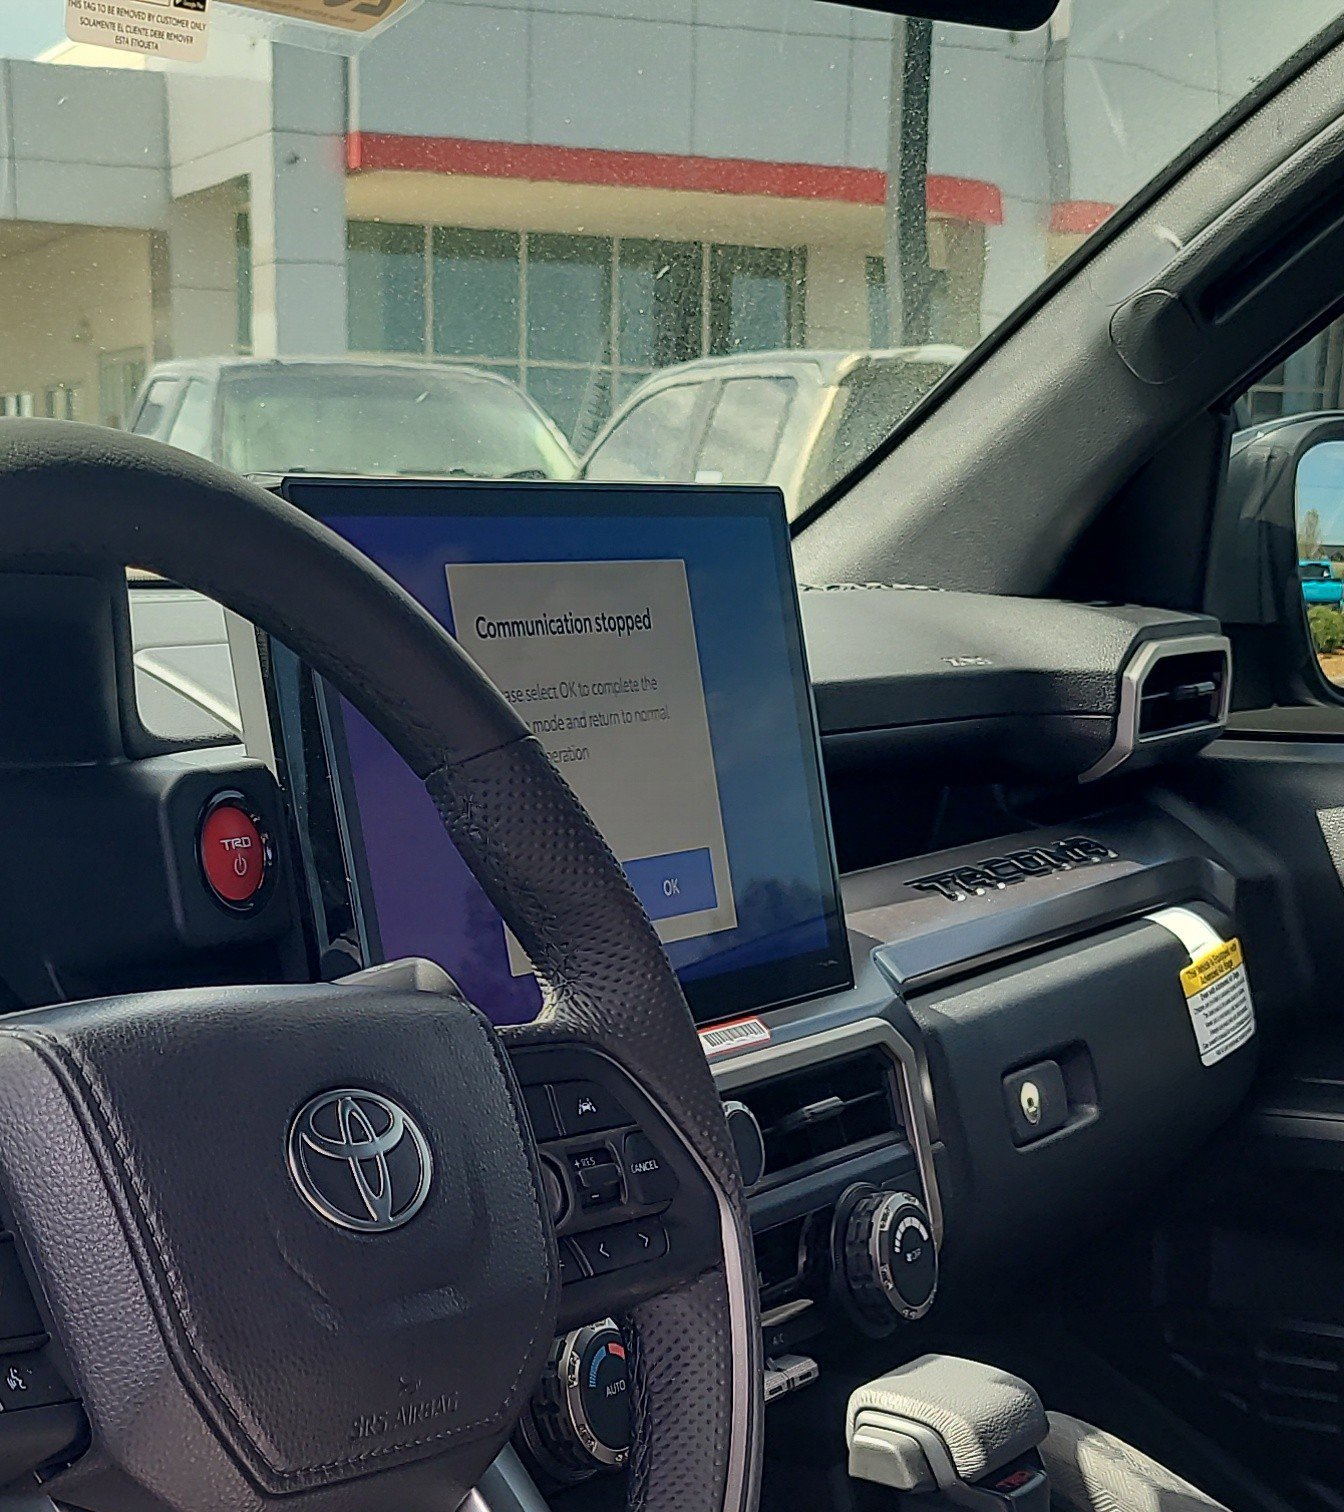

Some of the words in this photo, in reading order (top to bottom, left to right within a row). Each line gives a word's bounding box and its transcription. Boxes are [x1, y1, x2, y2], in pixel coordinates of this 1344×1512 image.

[79, 16, 116, 31] SOLAMENTE
[117, 23, 125, 33] EL
[150, 28, 165, 40] DEBE
[83, 1, 97, 12] TAG
[97, 3, 107, 13] TO
[107, 5, 115, 15] BE
[116, 6, 146, 21] REMOVED
[147, 11, 155, 22] BY
[156, 12, 189, 28] CUSTOMER
[190, 20, 207, 31] ONLY
[115, 35, 130, 46] ESTA
[130, 37, 159, 51] ETIQUETA
[475, 612, 593, 639] Communication
[595, 608, 652, 637] stopped
[504, 689, 523, 704] ase
[525, 684, 557, 701] select
[559, 681, 576, 698] OK
[577, 682, 590, 697] to
[592, 677, 639, 698] complete
[640, 675, 658, 691] the
[533, 715, 565, 733] mode
[567, 712, 587, 730] and
[589, 711, 620, 729] return
[622, 709, 633, 724] to
[219, 836, 252, 851] TRD
[903, 835, 1119, 902] TACOMA
[663, 878, 680, 896] OK
[631, 1160, 659, 1174] CANCEL
[606, 1379, 626, 1398] AUTO
